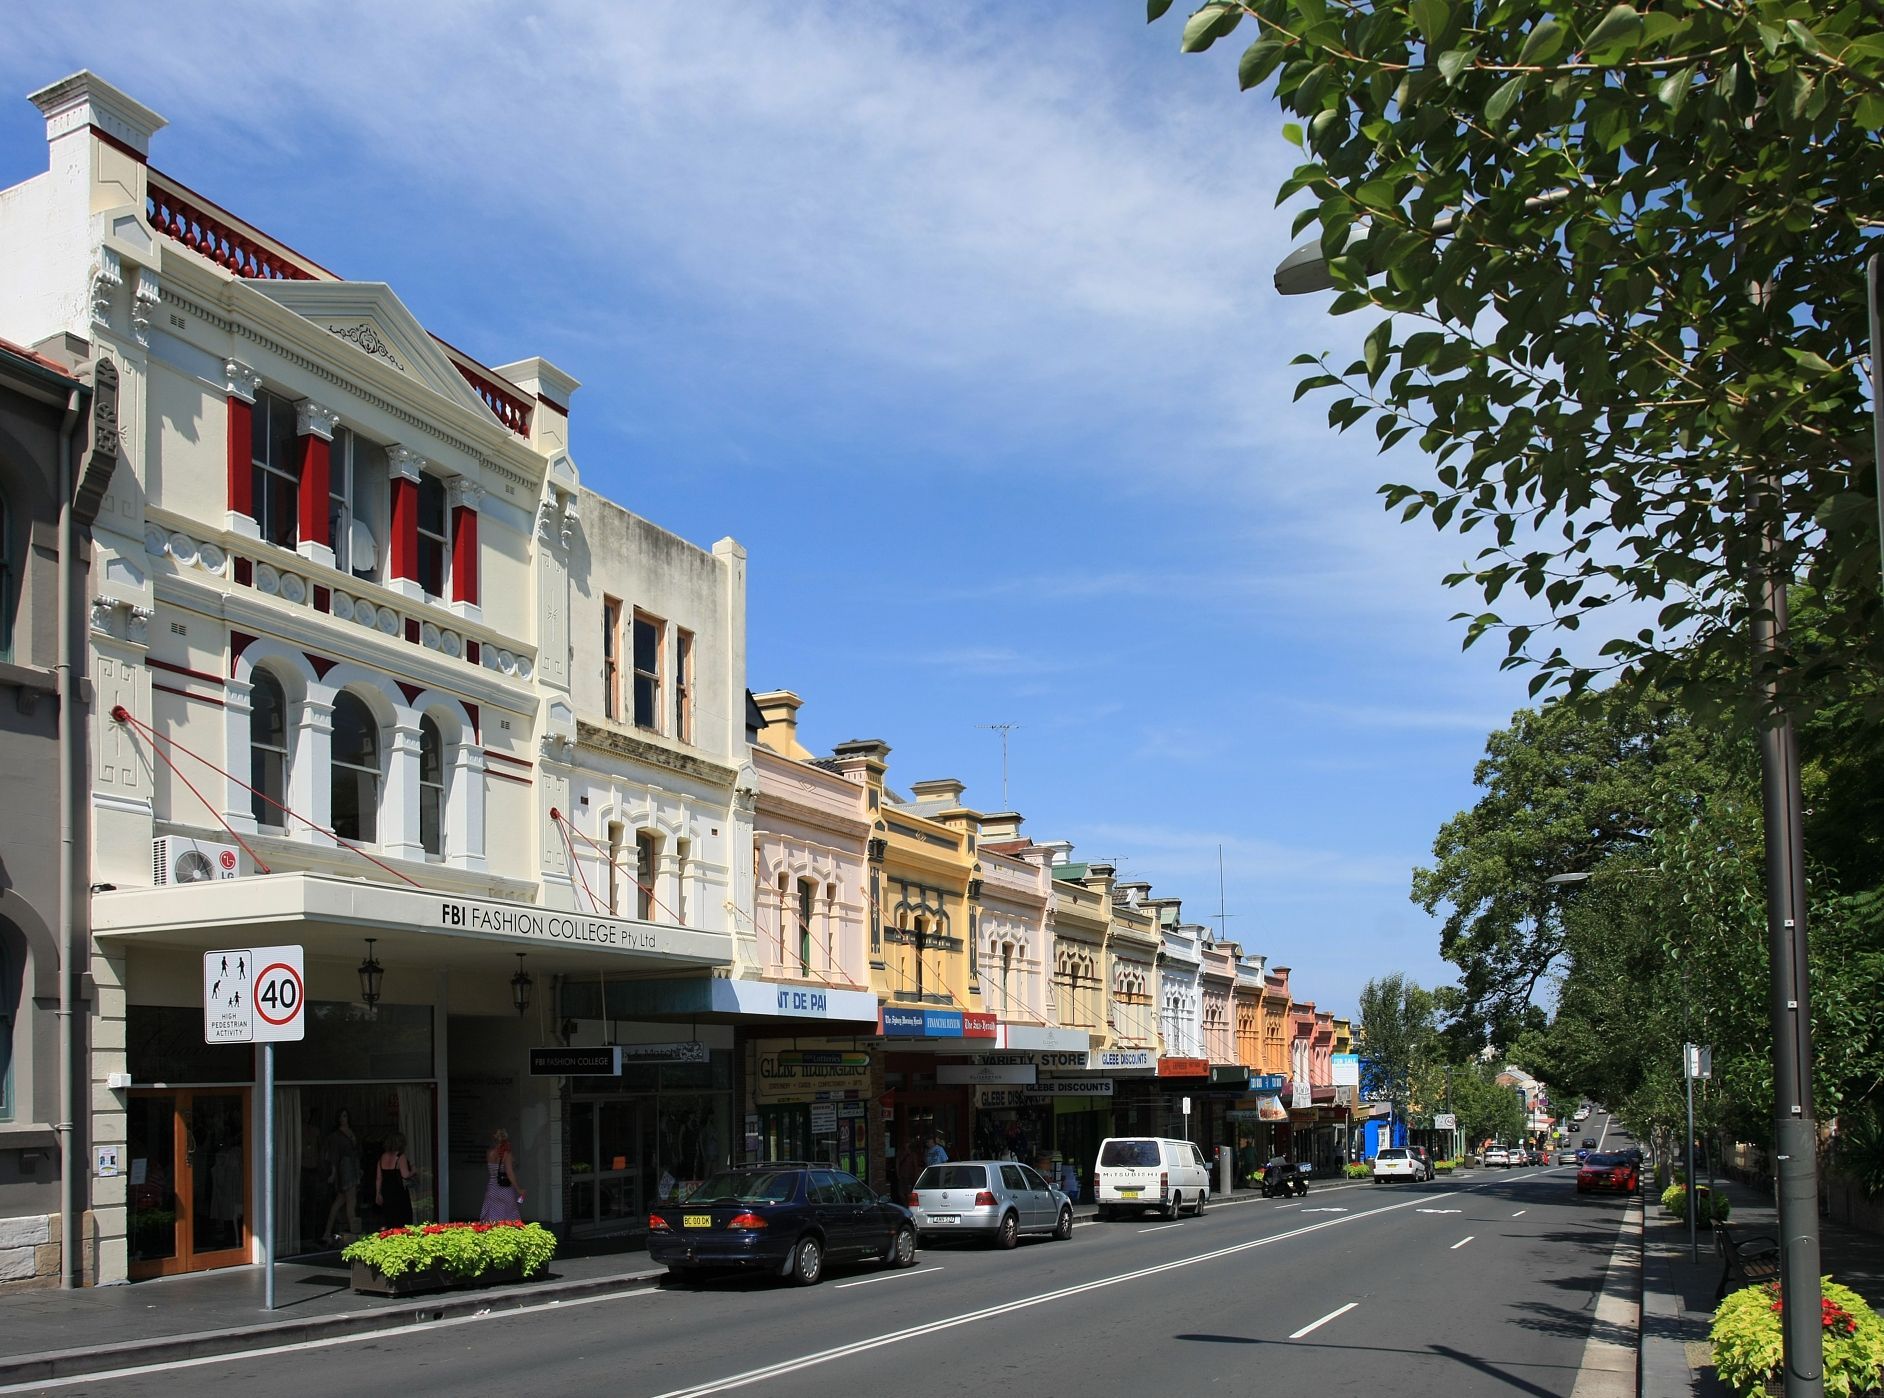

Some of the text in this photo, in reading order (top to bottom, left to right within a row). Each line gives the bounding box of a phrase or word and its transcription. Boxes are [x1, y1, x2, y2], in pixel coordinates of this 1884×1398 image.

[442, 903, 656, 949] FBI FASHION COLLEGE Pty Ltd
[261, 978, 296, 1009] 40
[793, 992, 807, 1010] DE
[211, 1020, 247, 1028] PEDESTRIAN
[964, 1018, 973, 1029] The
[215, 1029, 243, 1037] ACTIVITY
[535, 1057, 609, 1066] FBI FASHION COLLEGE
[981, 1053, 1086, 1066] VARIETY STORE
[1102, 1052, 1147, 1065] GLEBE DISCOUNTS
[1025, 1082, 1111, 1092] GLEBE DISCOUNTS
[981, 1091, 1006, 1106] GLEBE
